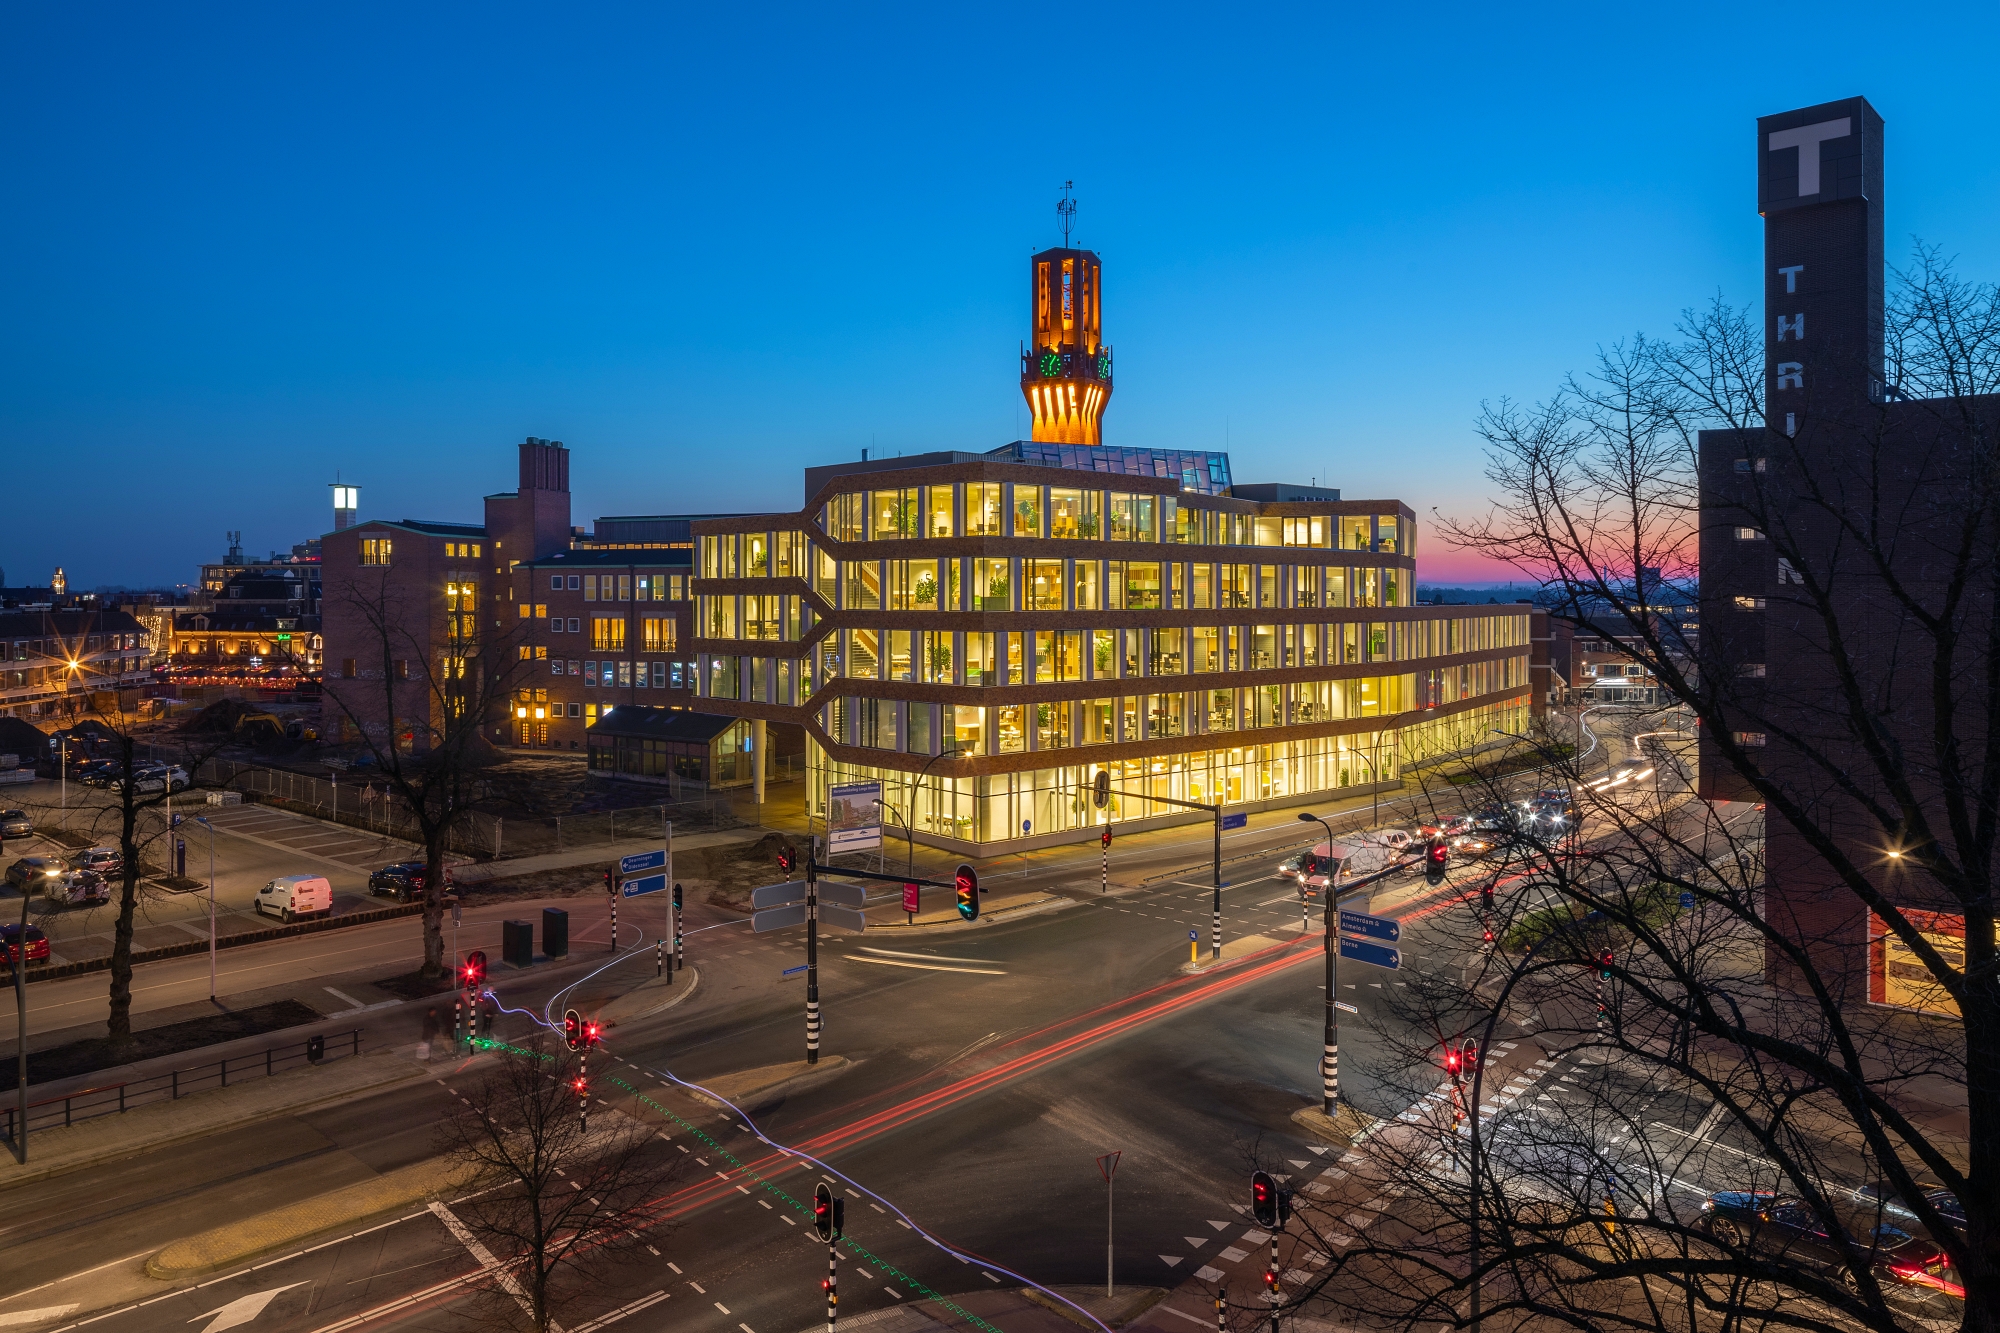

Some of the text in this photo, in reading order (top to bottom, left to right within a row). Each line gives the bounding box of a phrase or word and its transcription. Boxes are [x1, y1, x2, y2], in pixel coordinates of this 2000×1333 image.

[1769, 117, 1851, 197] T
[175, 814, 180, 822] P
[1341, 913, 1373, 925] Amsterdam
[1341, 922, 1362, 932] Almelo
[1341, 939, 1359, 949] Borne
